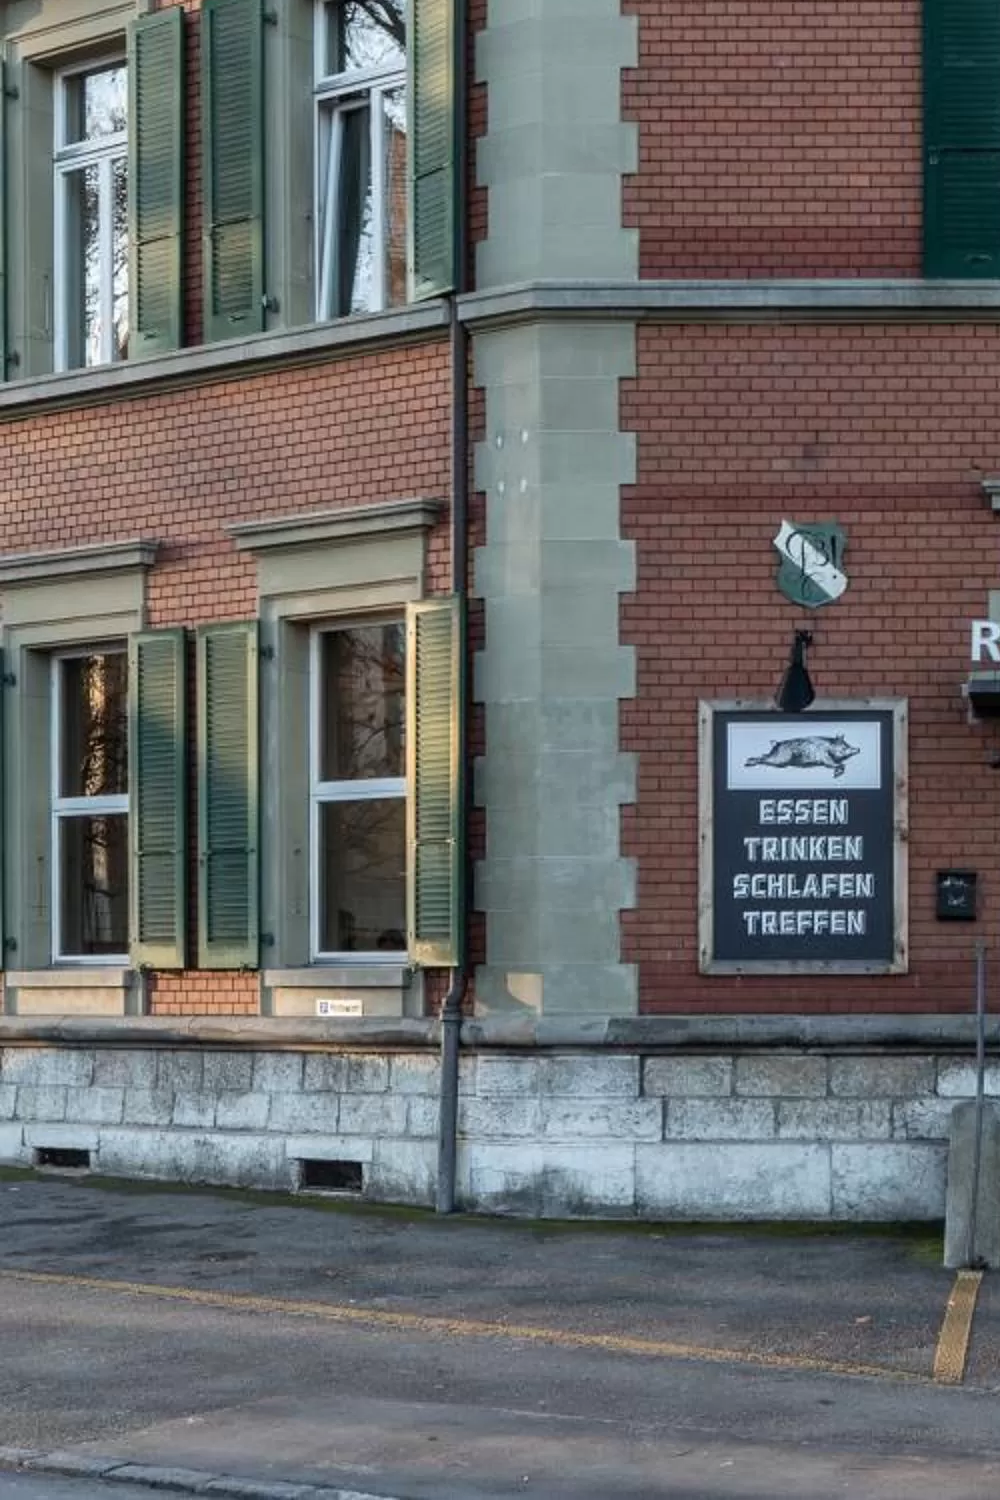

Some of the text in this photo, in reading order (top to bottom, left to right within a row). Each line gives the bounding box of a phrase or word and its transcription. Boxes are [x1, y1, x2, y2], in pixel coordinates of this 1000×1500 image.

[759, 799, 849, 825] ESSEN
[743, 835, 863, 862] TRINKEN
[733, 872, 875, 899] SCHLAFEN
[743, 909, 866, 936] TREFFEN
